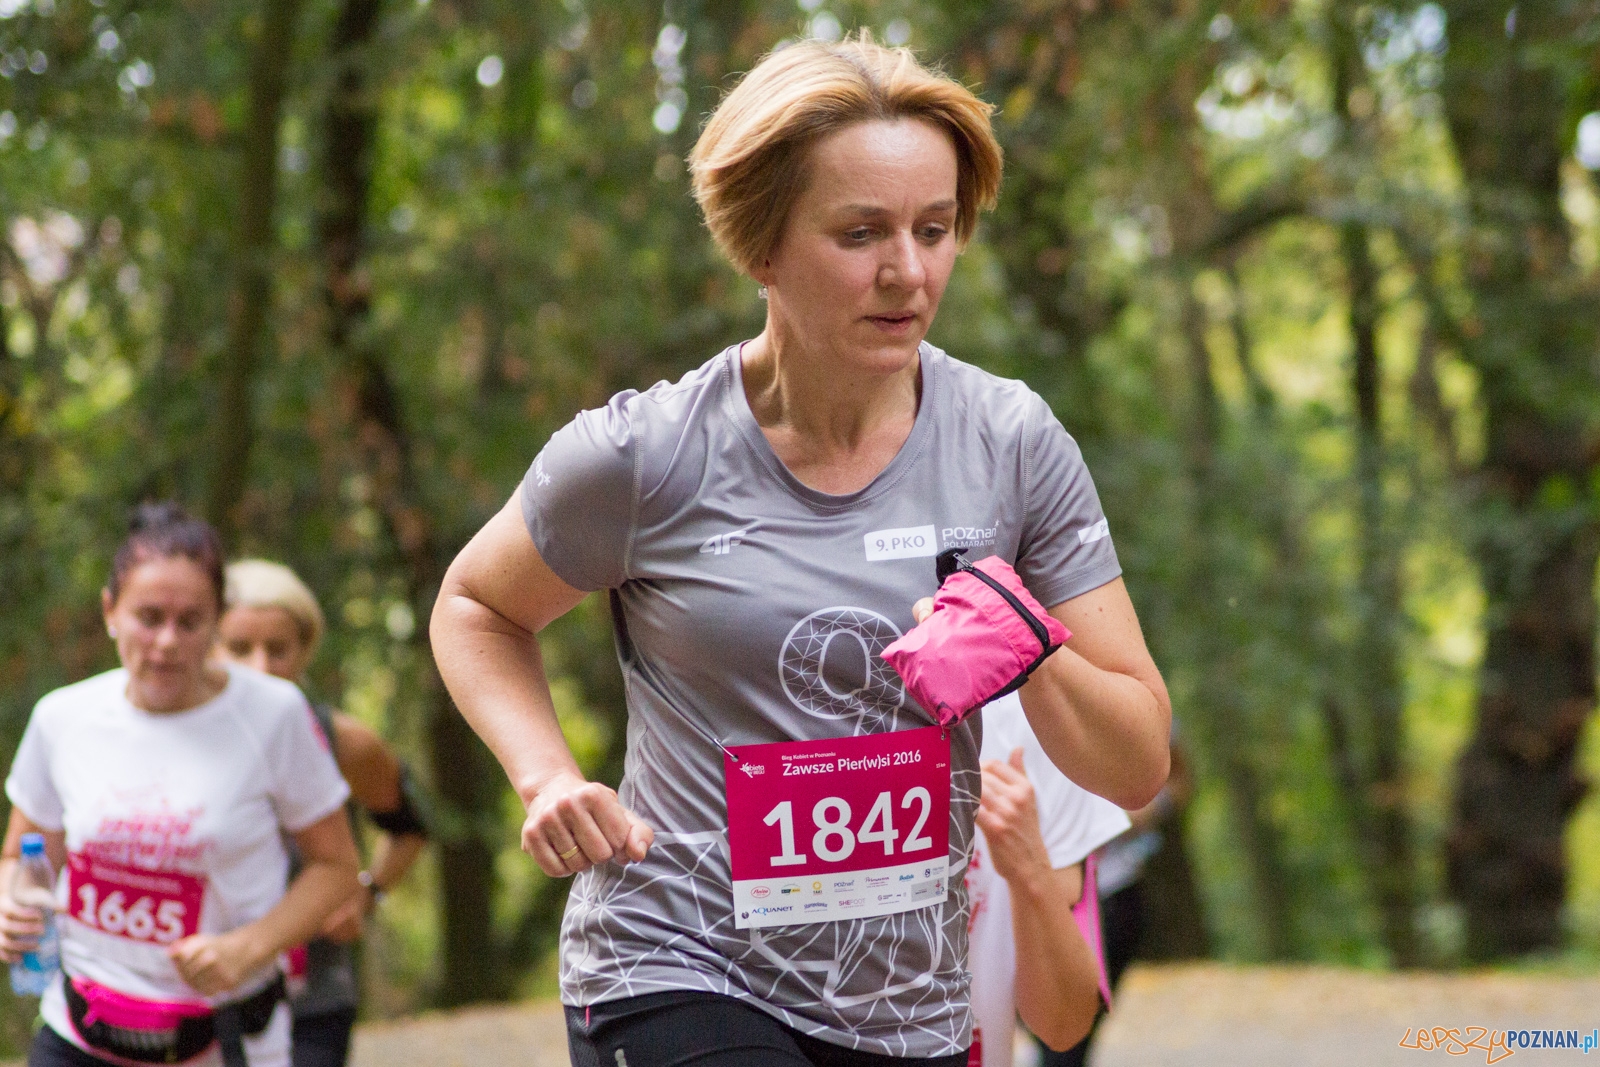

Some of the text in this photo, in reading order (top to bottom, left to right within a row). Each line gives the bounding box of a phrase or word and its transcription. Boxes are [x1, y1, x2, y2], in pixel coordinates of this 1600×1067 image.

[699, 530, 747, 555] 4F
[876, 535, 926, 552] 9. PKO
[782, 749, 921, 777] Zawsze Pier(w)si 2016
[814, 751, 836, 759] Poznaniu
[762, 785, 933, 867] 1842
[77, 883, 187, 943] 1665
